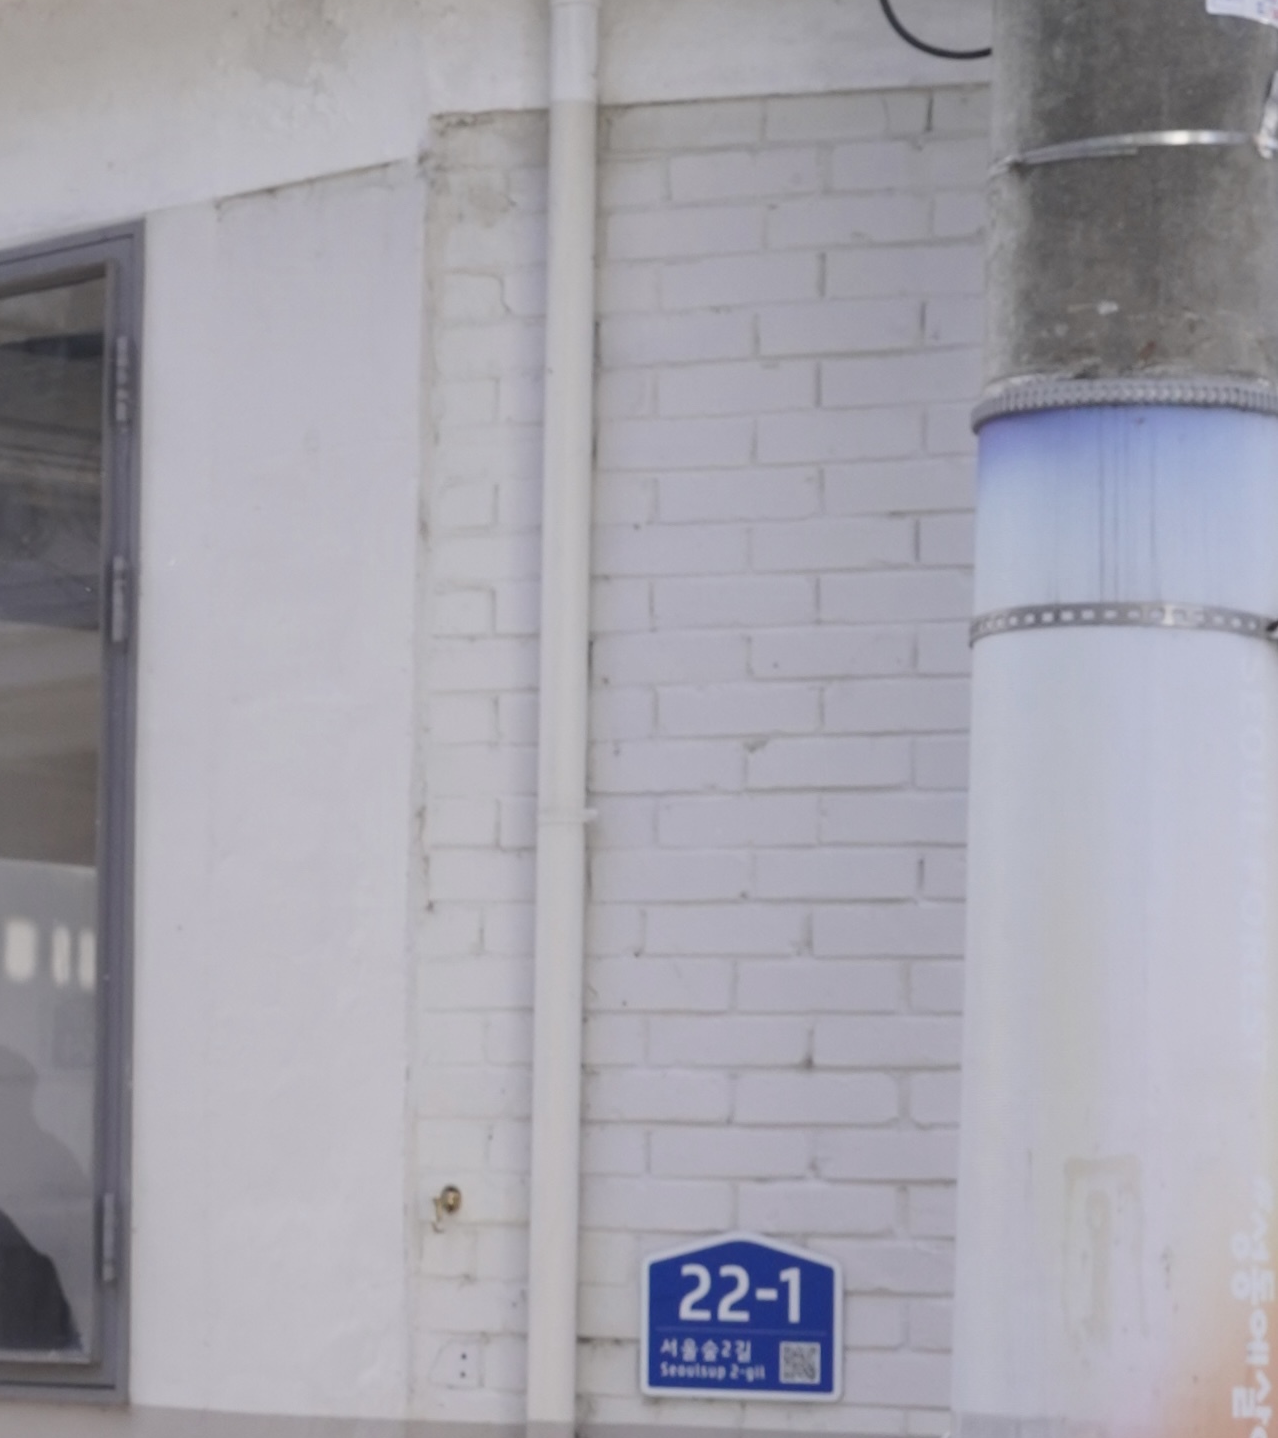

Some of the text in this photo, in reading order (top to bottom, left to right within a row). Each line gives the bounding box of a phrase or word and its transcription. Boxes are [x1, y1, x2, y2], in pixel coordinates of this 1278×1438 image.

[678, 1262, 802, 1324] 22-1
[659, 1360, 766, 1383] Seoulsup 2-gil
